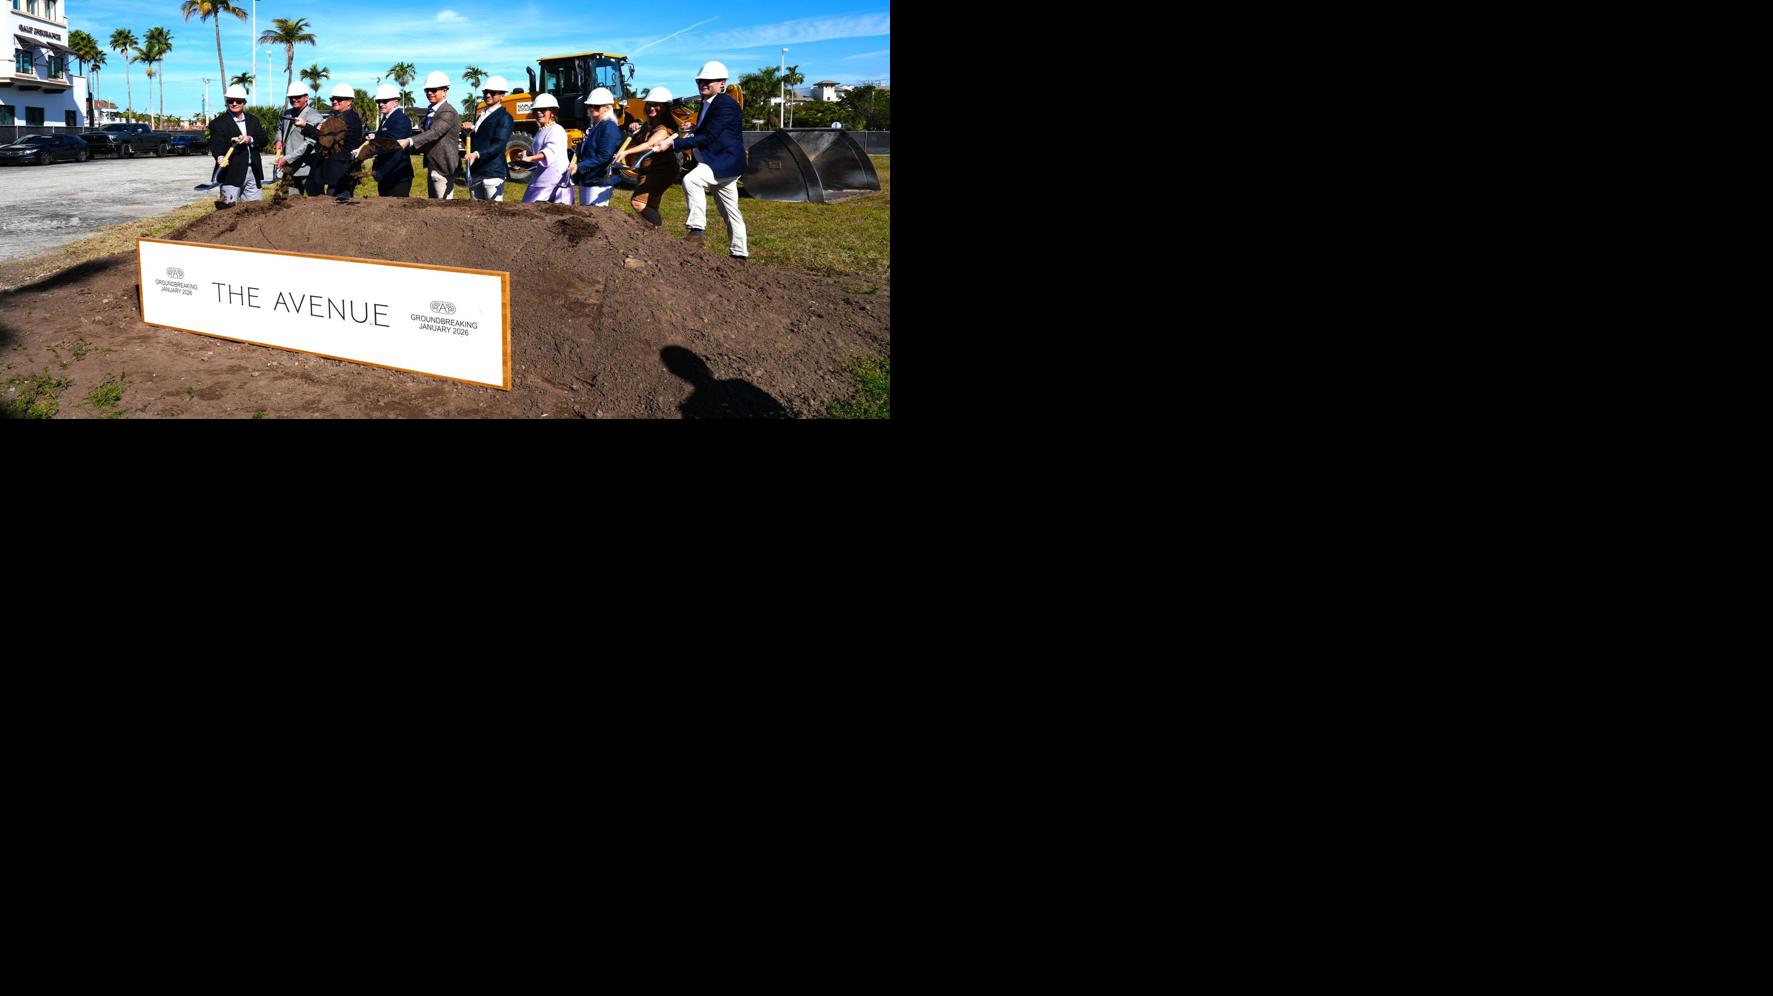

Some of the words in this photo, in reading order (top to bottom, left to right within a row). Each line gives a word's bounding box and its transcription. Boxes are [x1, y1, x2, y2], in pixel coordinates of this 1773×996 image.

[154, 278, 198, 291] GROUNDBREAKING
[161, 286, 181, 294] JANUARY
[182, 288, 193, 296] 2026
[211, 281, 261, 309] THE
[273, 291, 390, 328] AVENUE
[410, 313, 478, 330] GROUNDBREAKING
[418, 322, 451, 334] JANUARY
[452, 327, 469, 337] 2026
